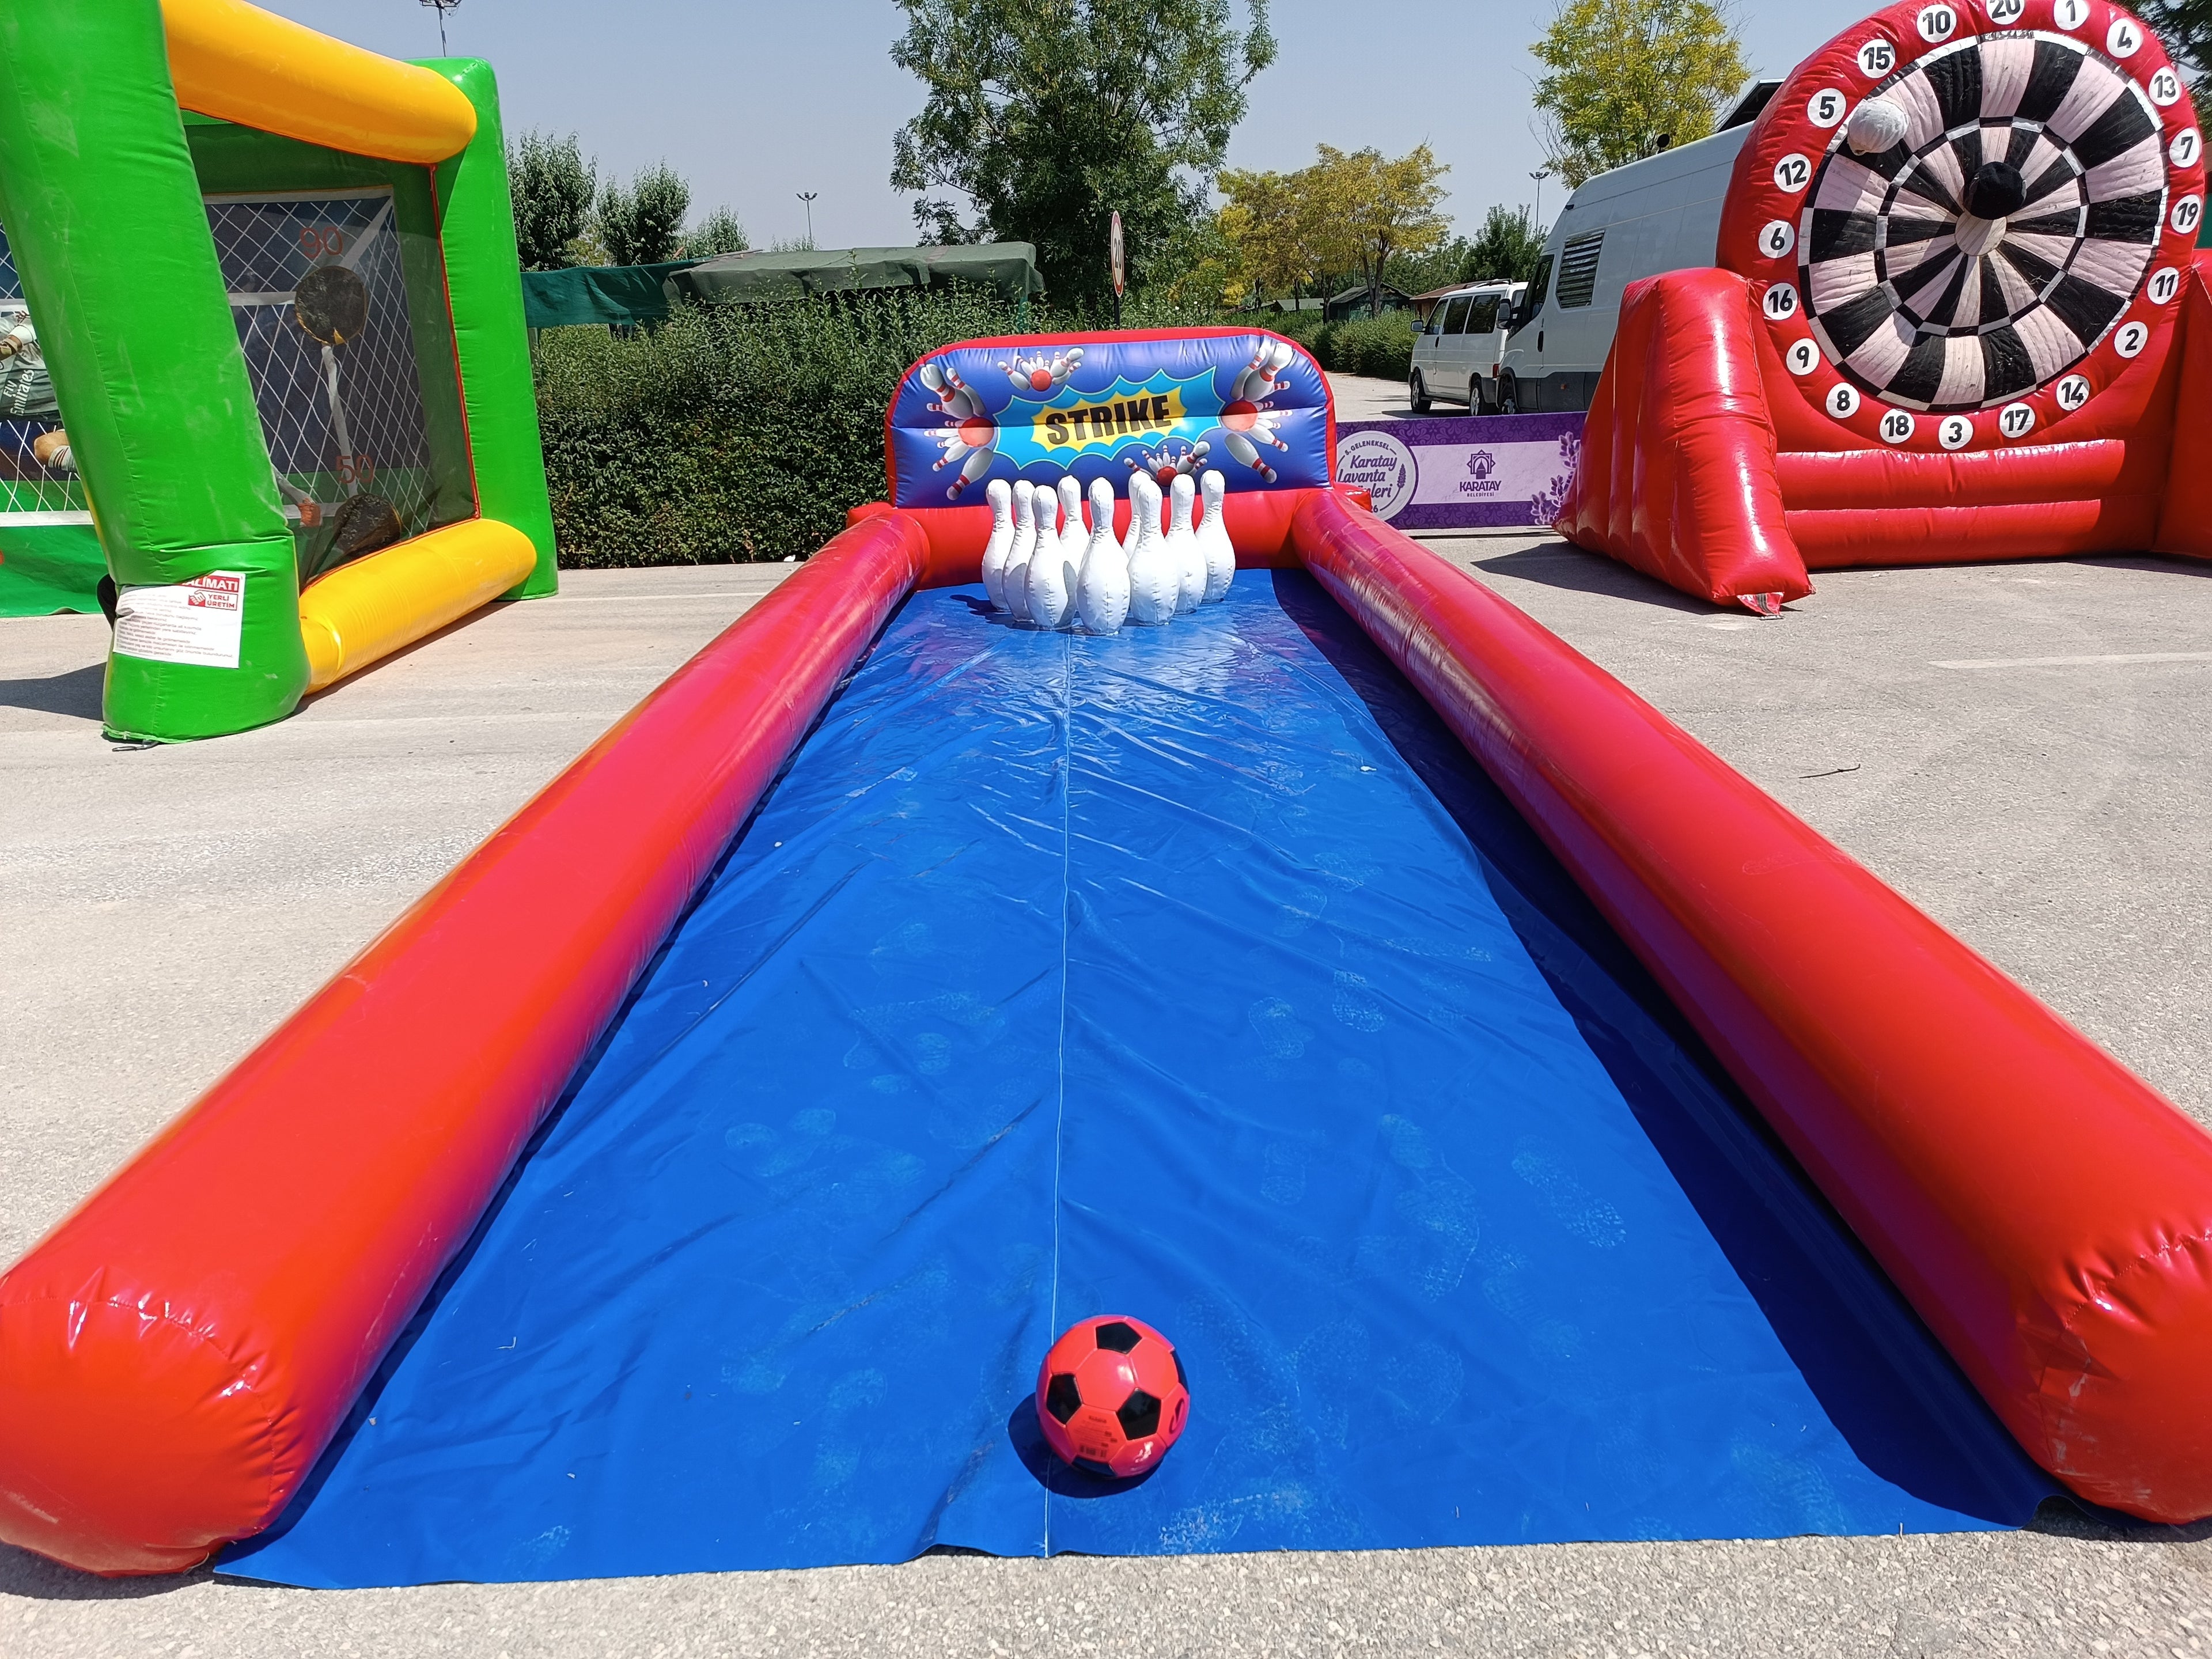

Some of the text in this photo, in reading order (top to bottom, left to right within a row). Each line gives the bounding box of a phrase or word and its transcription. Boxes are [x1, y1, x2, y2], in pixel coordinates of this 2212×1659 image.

[1990, 0, 2021, 19] 20
[2066, 0, 2076, 22] 1
[1925, 10, 1951, 36] 10
[2117, 26, 2133, 48] 4
[1863, 46, 1891, 71] 15
[2154, 74, 2176, 98] 13
[1819, 96, 1836, 120] 5
[2180, 136, 2193, 160] 7
[1778, 160, 1807, 185] 12
[2177, 202, 2199, 226] 19
[300, 226, 343, 259] 90
[1770, 227, 1785, 251] 6
[1113, 237, 1122, 271] 20
[2154, 275, 2175, 298] 11
[1767, 288, 1793, 314] 16
[2124, 328, 2139, 351] 2
[1796, 346, 1809, 369] 9
[3, 380, 17, 397] Fly
[10, 369, 35, 416] Emirates
[2061, 381, 2085, 404] 14
[1836, 389, 1850, 412] 8
[1046, 395, 1172, 445] STRIKE
[1884, 414, 1910, 437] 18
[2005, 408, 2030, 432] 17
[1948, 422, 1963, 444] 3
[1350, 440, 1389, 451] GELENEKSEL
[336, 454, 374, 483] 50
[1350, 454, 1397, 471] Karatay
[1337, 468, 1387, 483] Lavanta
[1459, 480, 1502, 492] KARATAY
[207, 600, 235, 608] ÜRETİM
